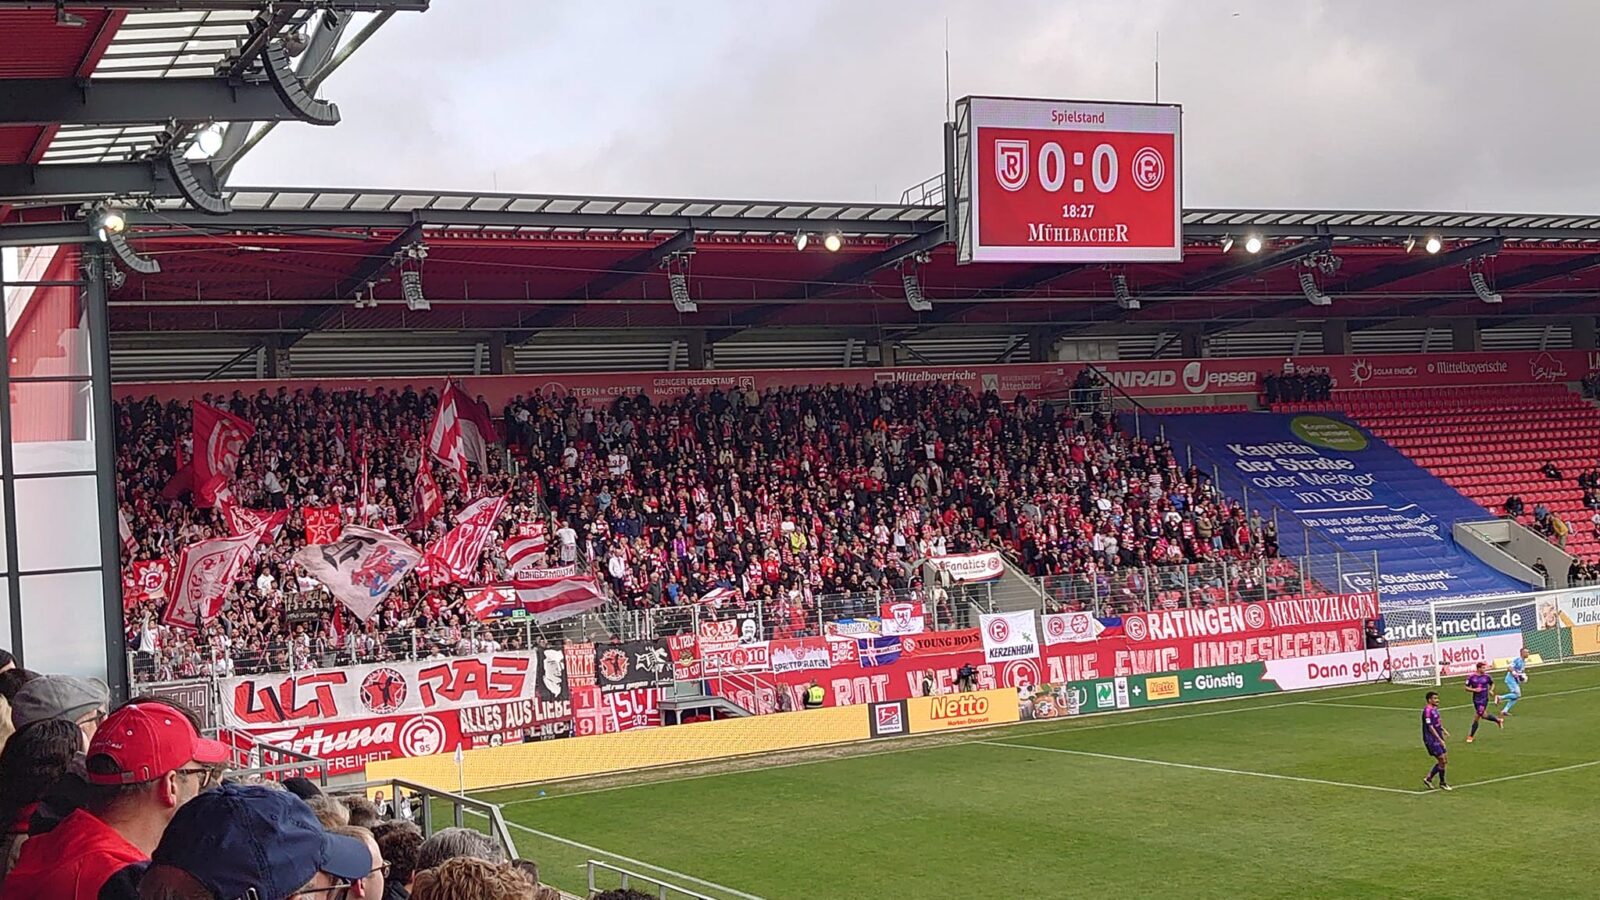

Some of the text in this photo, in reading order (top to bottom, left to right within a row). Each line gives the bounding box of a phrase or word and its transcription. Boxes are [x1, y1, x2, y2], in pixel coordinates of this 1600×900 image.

[1052, 110, 1104, 124] Spielstand
[1062, 204, 1094, 218] 18:27
[1437, 360, 1508, 375] Mittelbayerische
[653, 376, 736, 386] GIENGER REGENSTAUF
[896, 370, 976, 382] Mittelbayerische
[1226, 441, 1320, 458] Kapitän
[1236, 457, 1355, 472] der Straße
[1252, 474, 1300, 488] oder
[1290, 490, 1328, 504] im
[946, 560, 986, 571] Fanatics
[1572, 595, 1600, 608] Mittel
[1147, 605, 1246, 640] RATINGEN
[1267, 594, 1376, 628] MEINERZHAGEN
[1384, 610, 1522, 640] andre-media.de
[918, 632, 980, 648] YOUNG BOYS
[989, 644, 1034, 658] KERZENHEIM
[1308, 662, 1348, 680] Dann
[1352, 657, 1379, 674] geh
[1383, 652, 1418, 670] doch
[1442, 644, 1485, 664] Netto!
[1150, 680, 1175, 693] Netto
[1195, 672, 1244, 690] Günstig
[234, 671, 347, 725] ULT
[418, 657, 529, 708] RAS
[930, 694, 989, 720] Netto
[460, 698, 572, 734] ALLES AUS LIEBE
[250, 722, 396, 770] Fortuna
[326, 750, 392, 771] FREIHEIT
